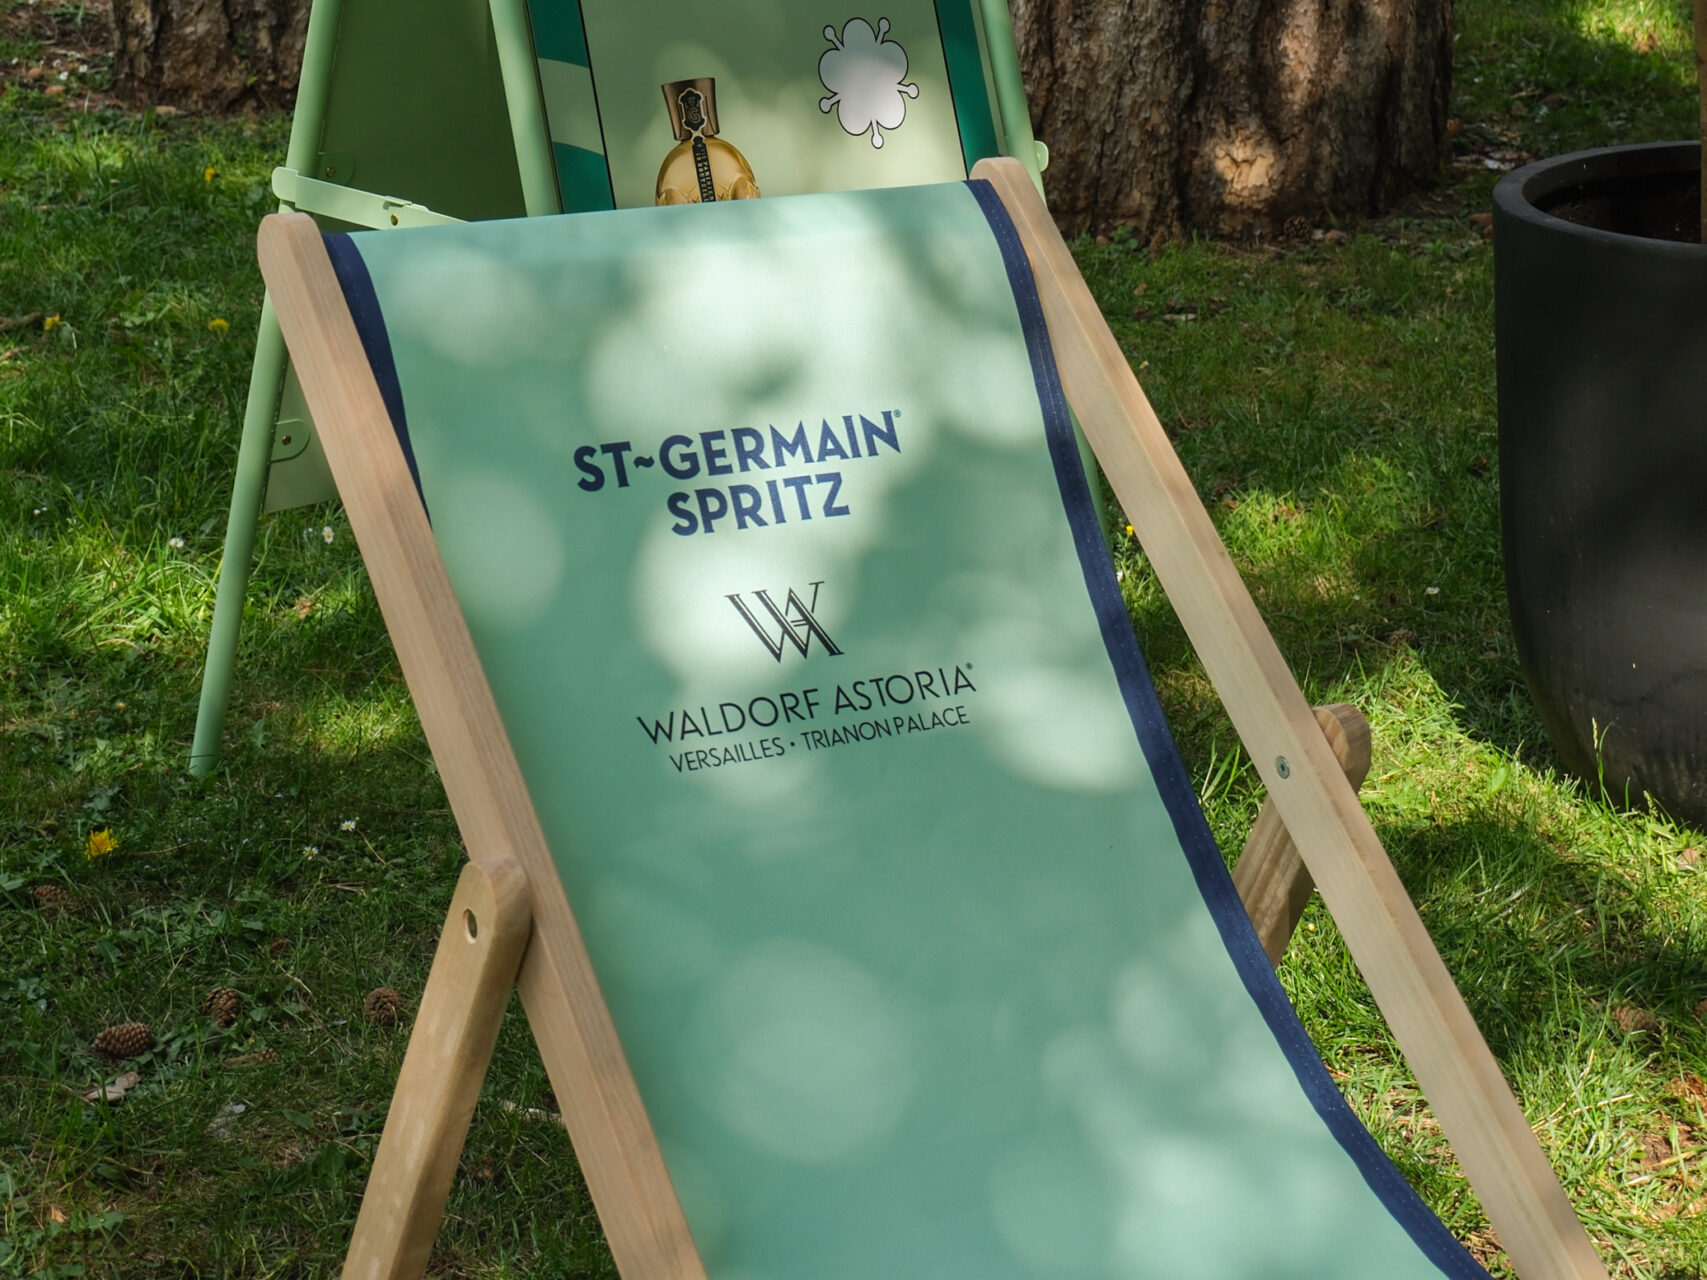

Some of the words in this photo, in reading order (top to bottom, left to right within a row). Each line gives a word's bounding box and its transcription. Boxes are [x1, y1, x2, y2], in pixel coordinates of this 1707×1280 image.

[666, 471, 851, 537] SPRITZ
[636, 688, 820, 745] WALDORF
[669, 737, 786, 773] VERSAILLES
[800, 717, 892, 752] TRIANON
[892, 705, 971, 737] PALACE
